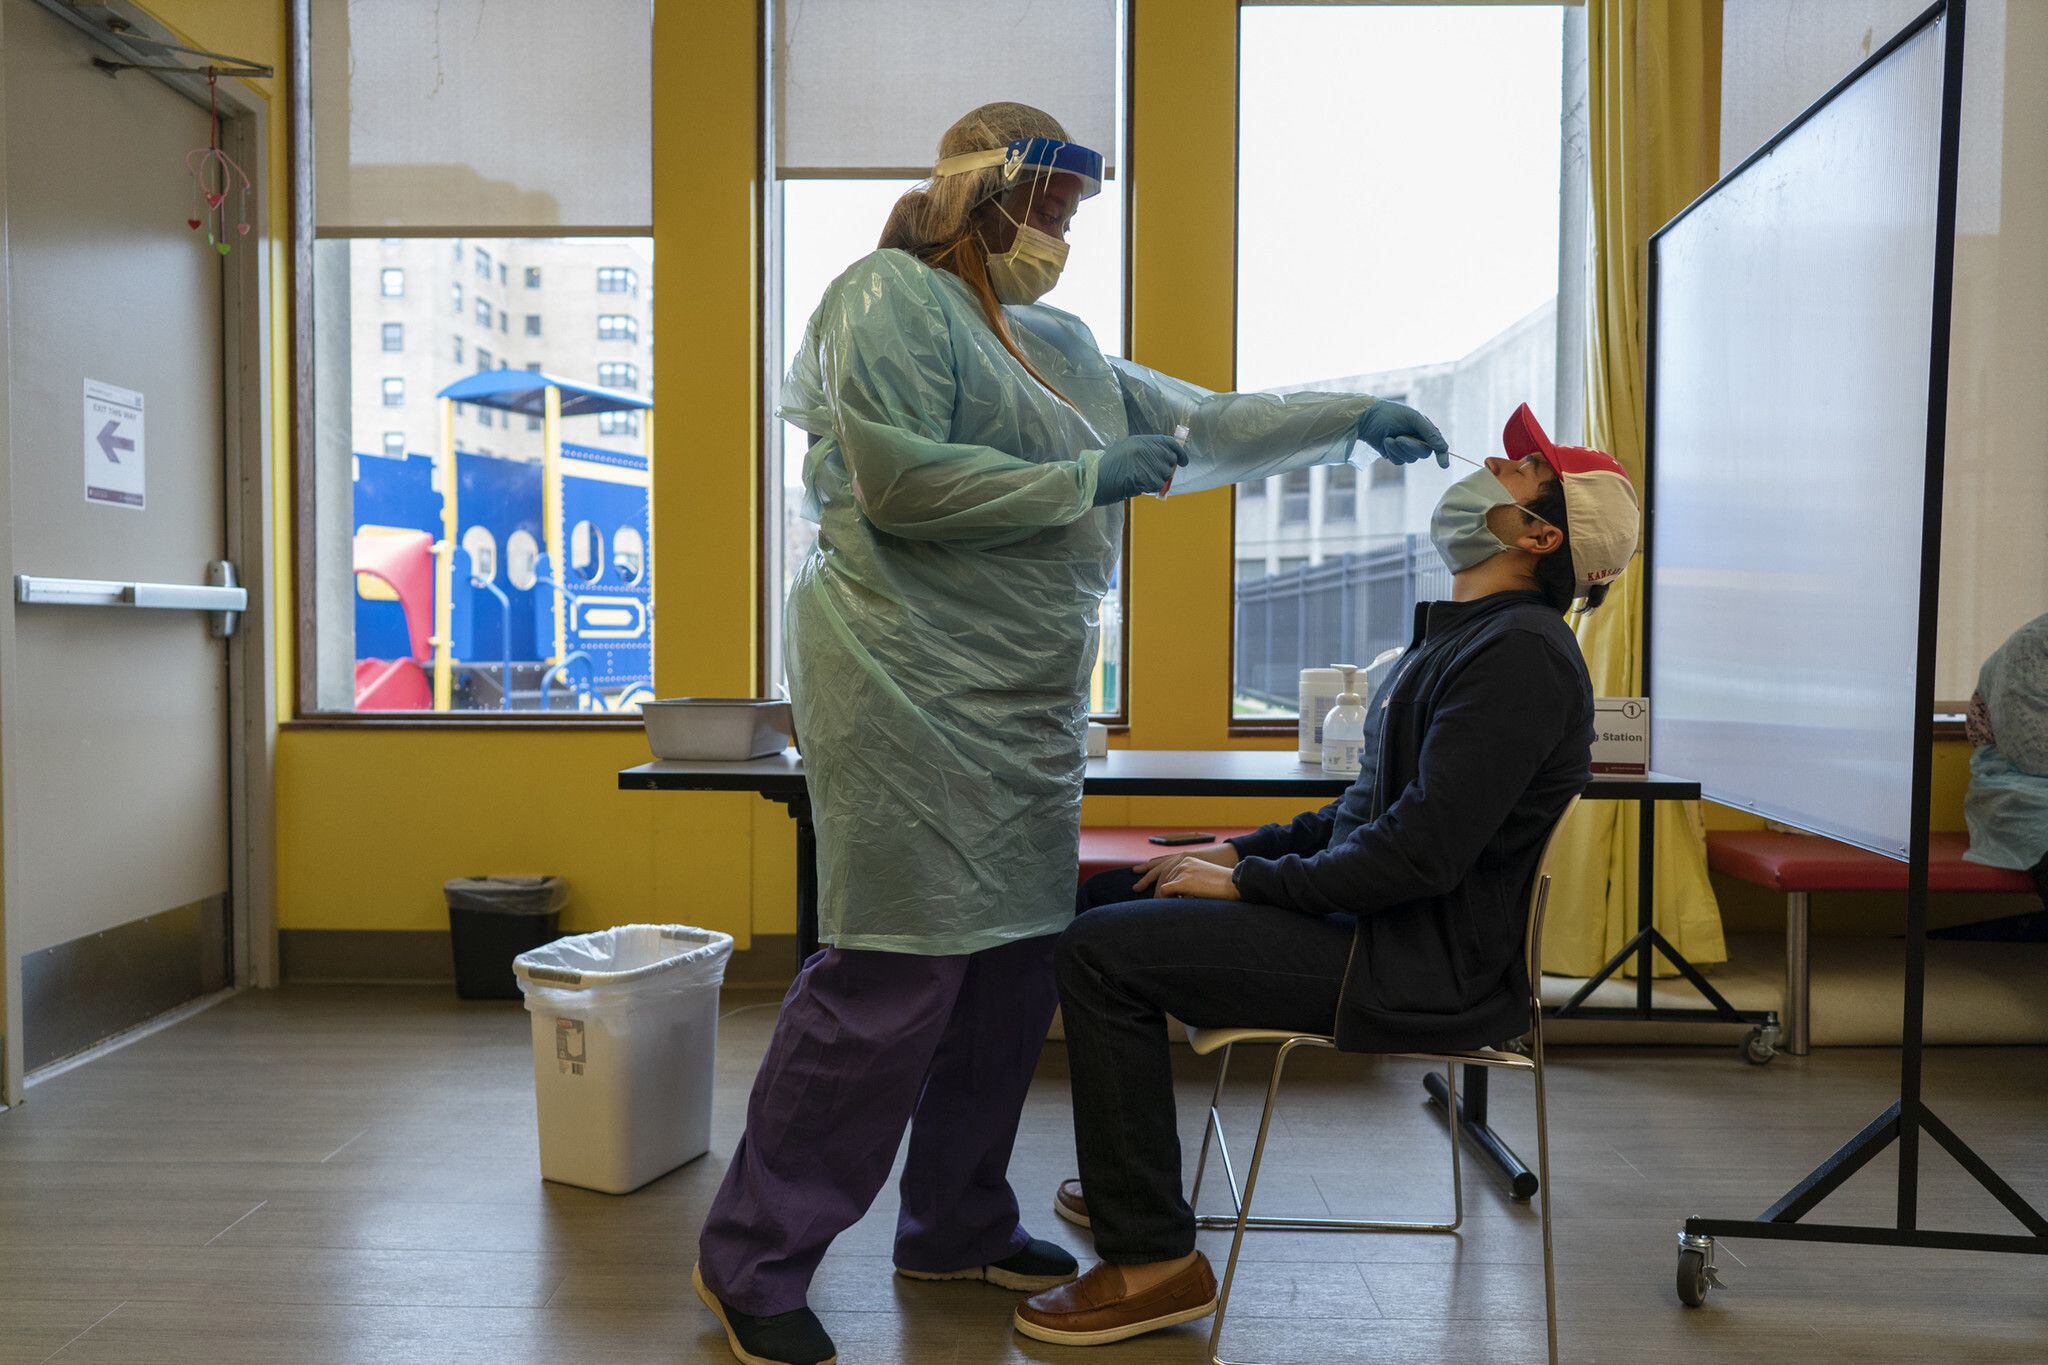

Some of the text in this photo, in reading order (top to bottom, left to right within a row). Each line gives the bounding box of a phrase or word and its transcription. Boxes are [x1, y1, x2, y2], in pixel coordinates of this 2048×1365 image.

[93, 403, 137, 420] EXIT THIS WAY
[1628, 705, 1635, 716] 1
[1603, 732, 1643, 742] Station
